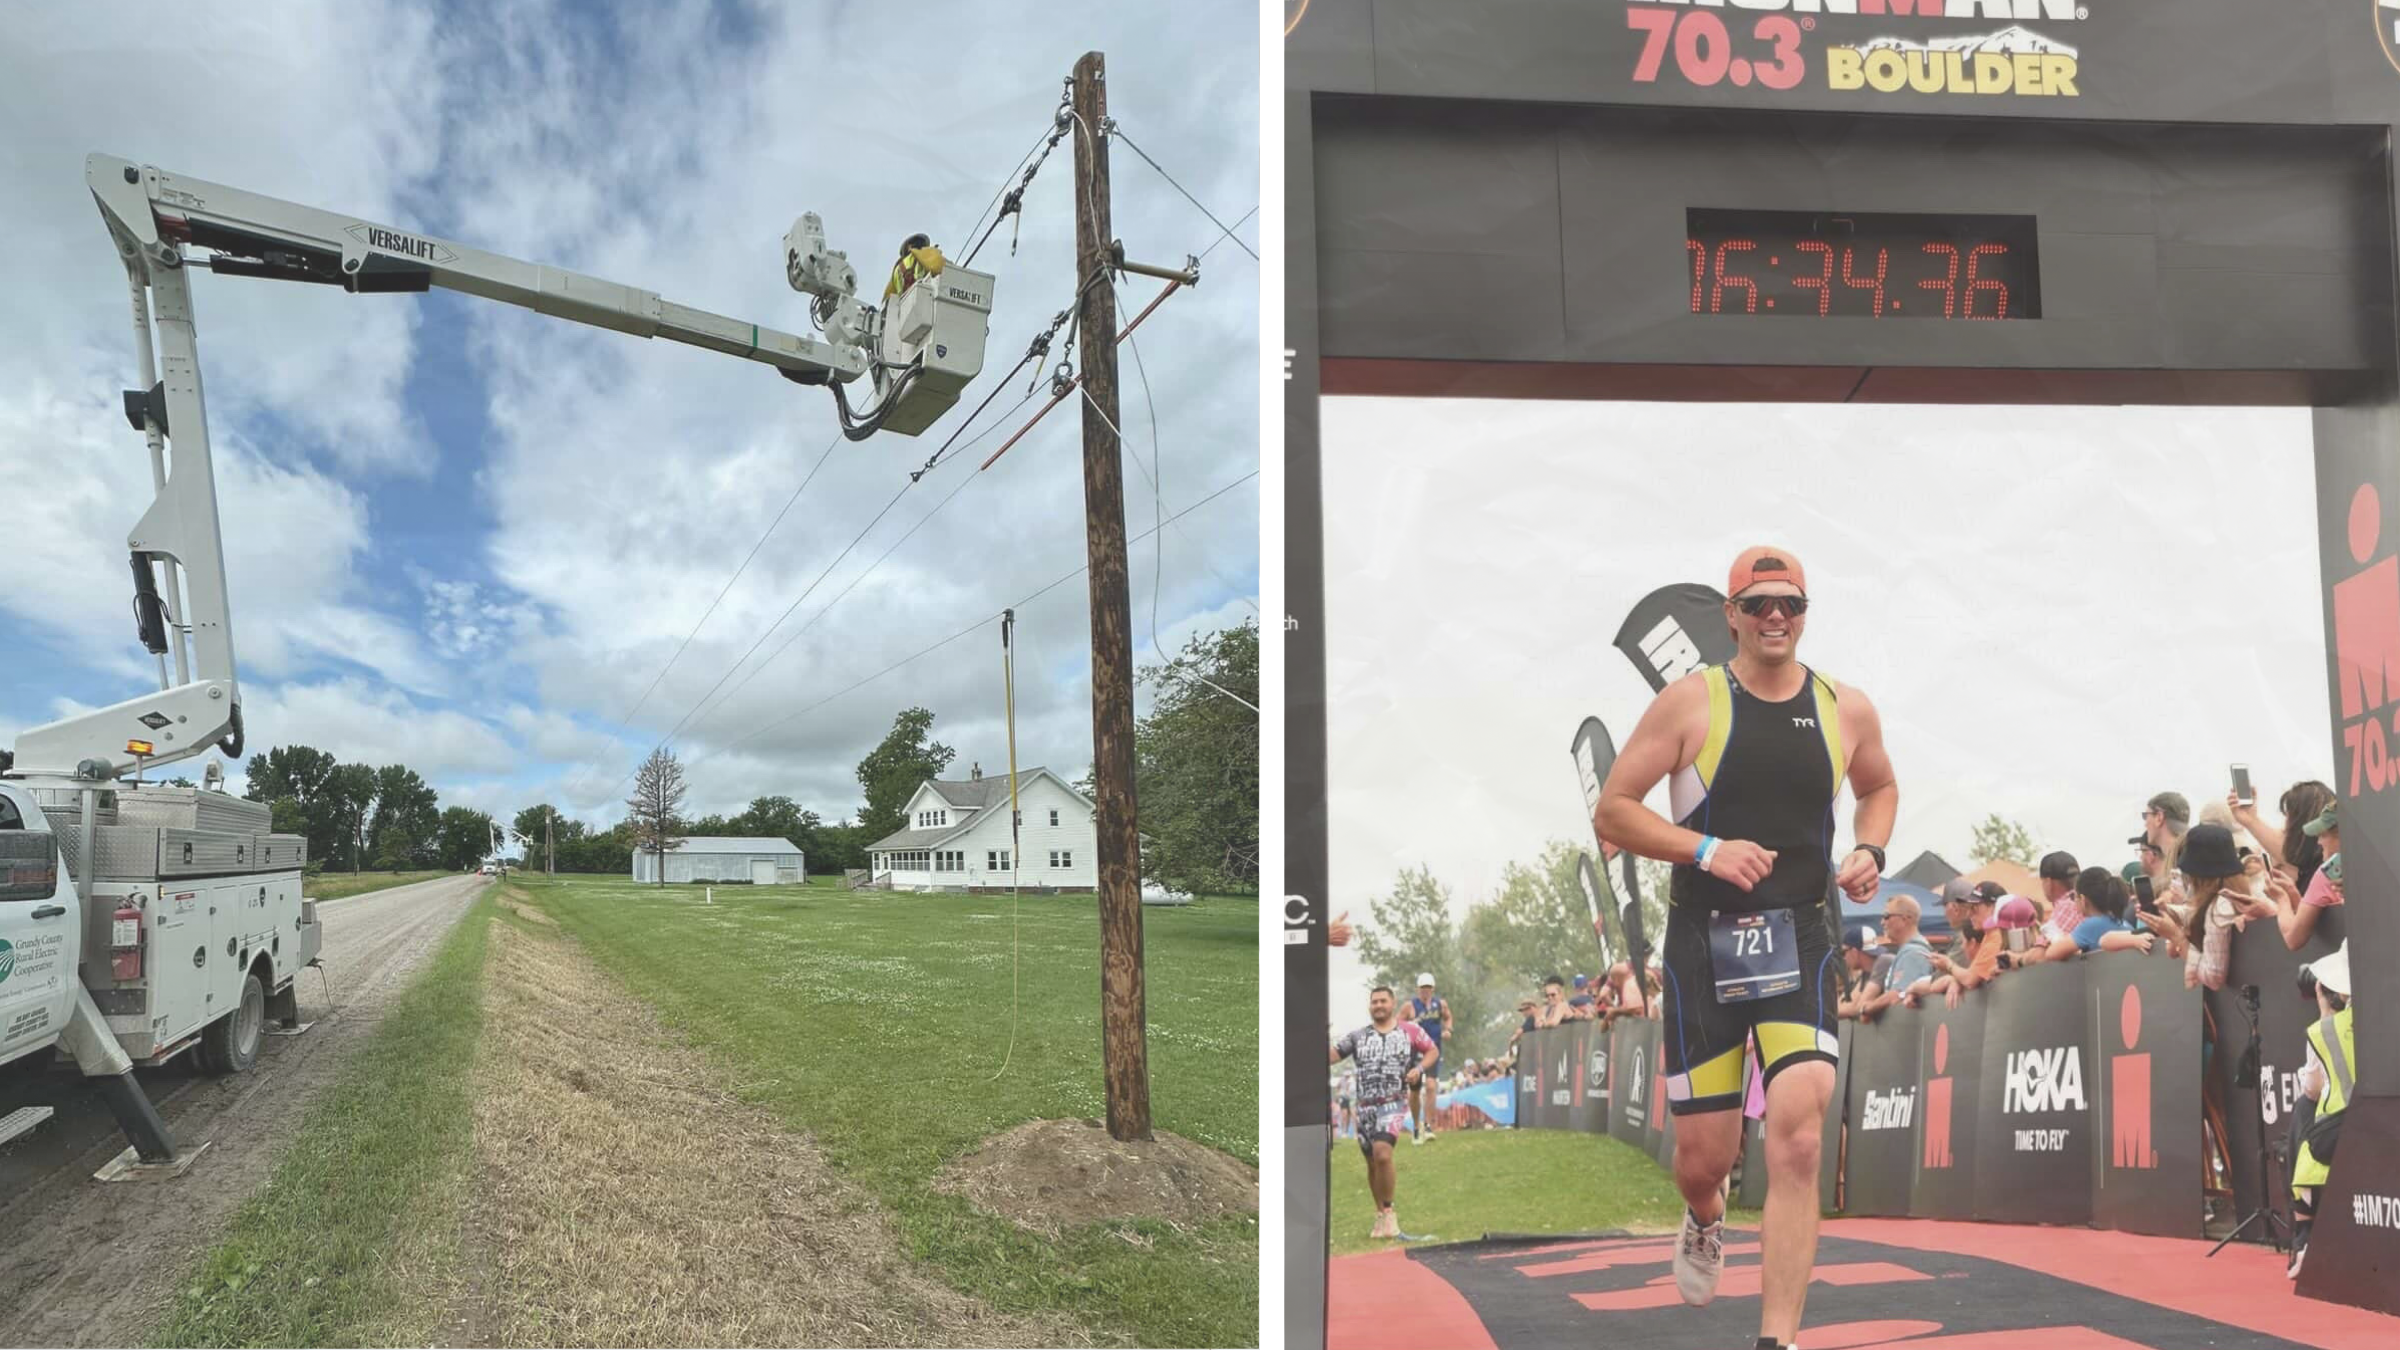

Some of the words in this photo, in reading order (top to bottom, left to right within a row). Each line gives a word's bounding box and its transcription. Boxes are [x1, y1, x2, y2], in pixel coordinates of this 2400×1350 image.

[1827, 46, 2080, 97] BOULDER
[368, 227, 436, 261] VERSALIFT
[1792, 717, 1816, 728] TYR
[15, 935, 41, 950] Grundy
[41, 934, 64, 946] County
[1731, 926, 1774, 957] 721
[15, 948, 34, 963] Rural
[34, 947, 59, 960] Electric
[14, 960, 54, 977] Cooperative
[2003, 1046, 2084, 1113] HOKA
[1862, 1086, 1916, 1130] Santini
[2015, 1130, 2035, 1151] TIME
[2035, 1130, 2048, 1150] TO
[2049, 1129, 2067, 1150] FLY
